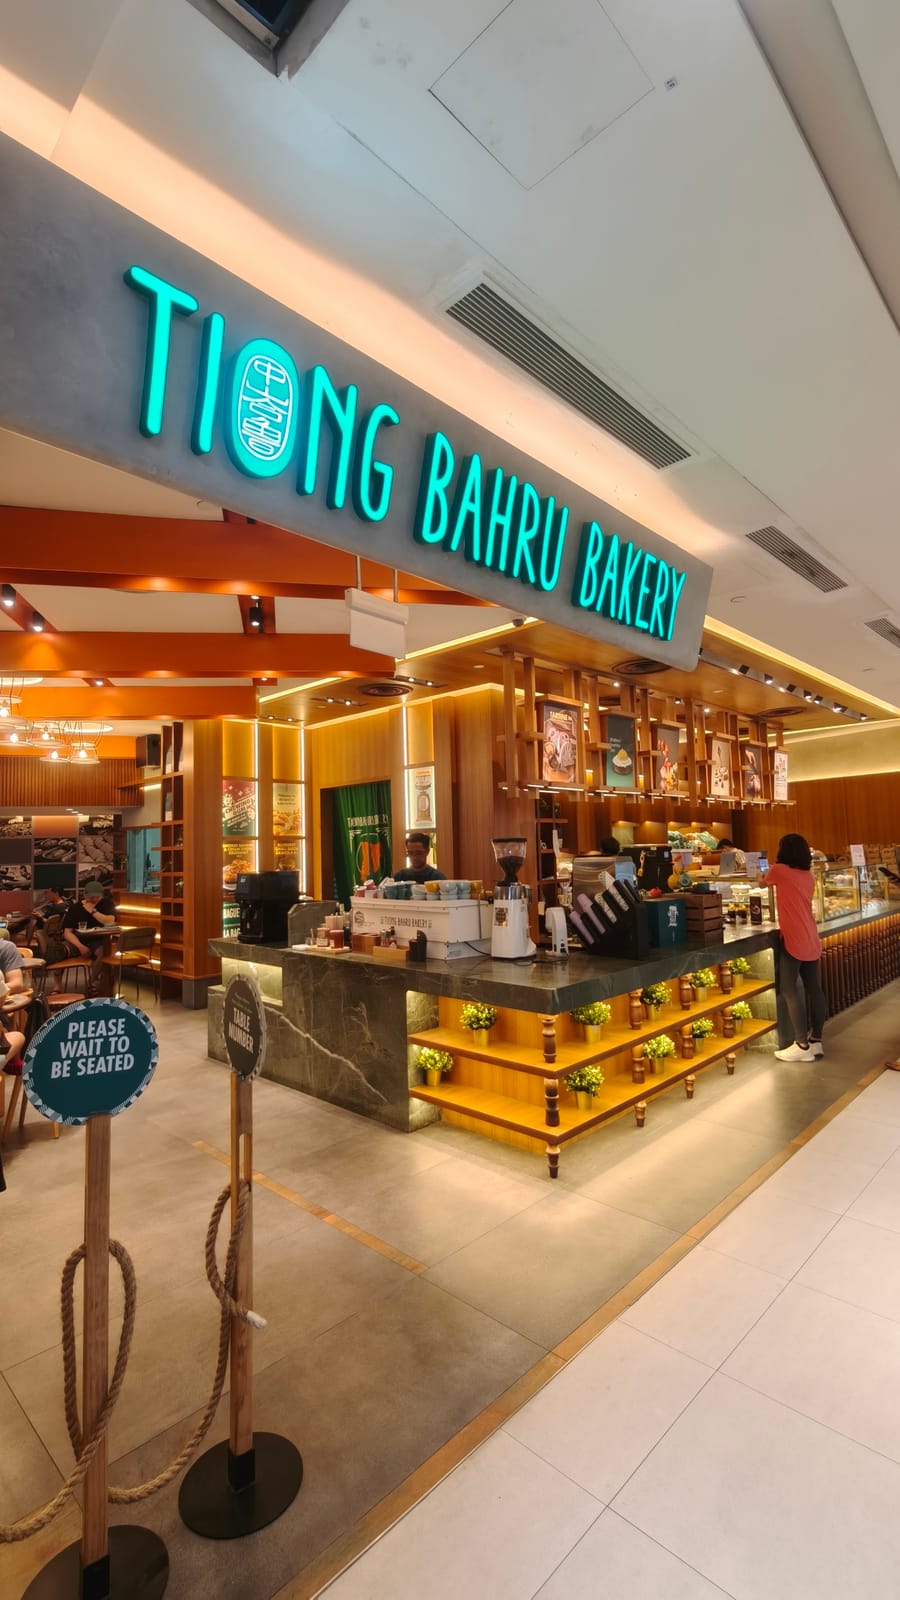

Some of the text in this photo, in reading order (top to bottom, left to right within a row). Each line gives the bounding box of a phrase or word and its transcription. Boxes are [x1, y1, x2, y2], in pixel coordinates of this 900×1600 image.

[123, 265, 686, 641] TIONG BAHRU BAKERY
[67, 1018, 126, 1040] PLEASE
[233, 1007, 251, 1032] TABLE
[60, 1036, 130, 1059] WAIT TO
[228, 1021, 254, 1054] NUMBER
[51, 1054, 135, 1079] BE SEATED
